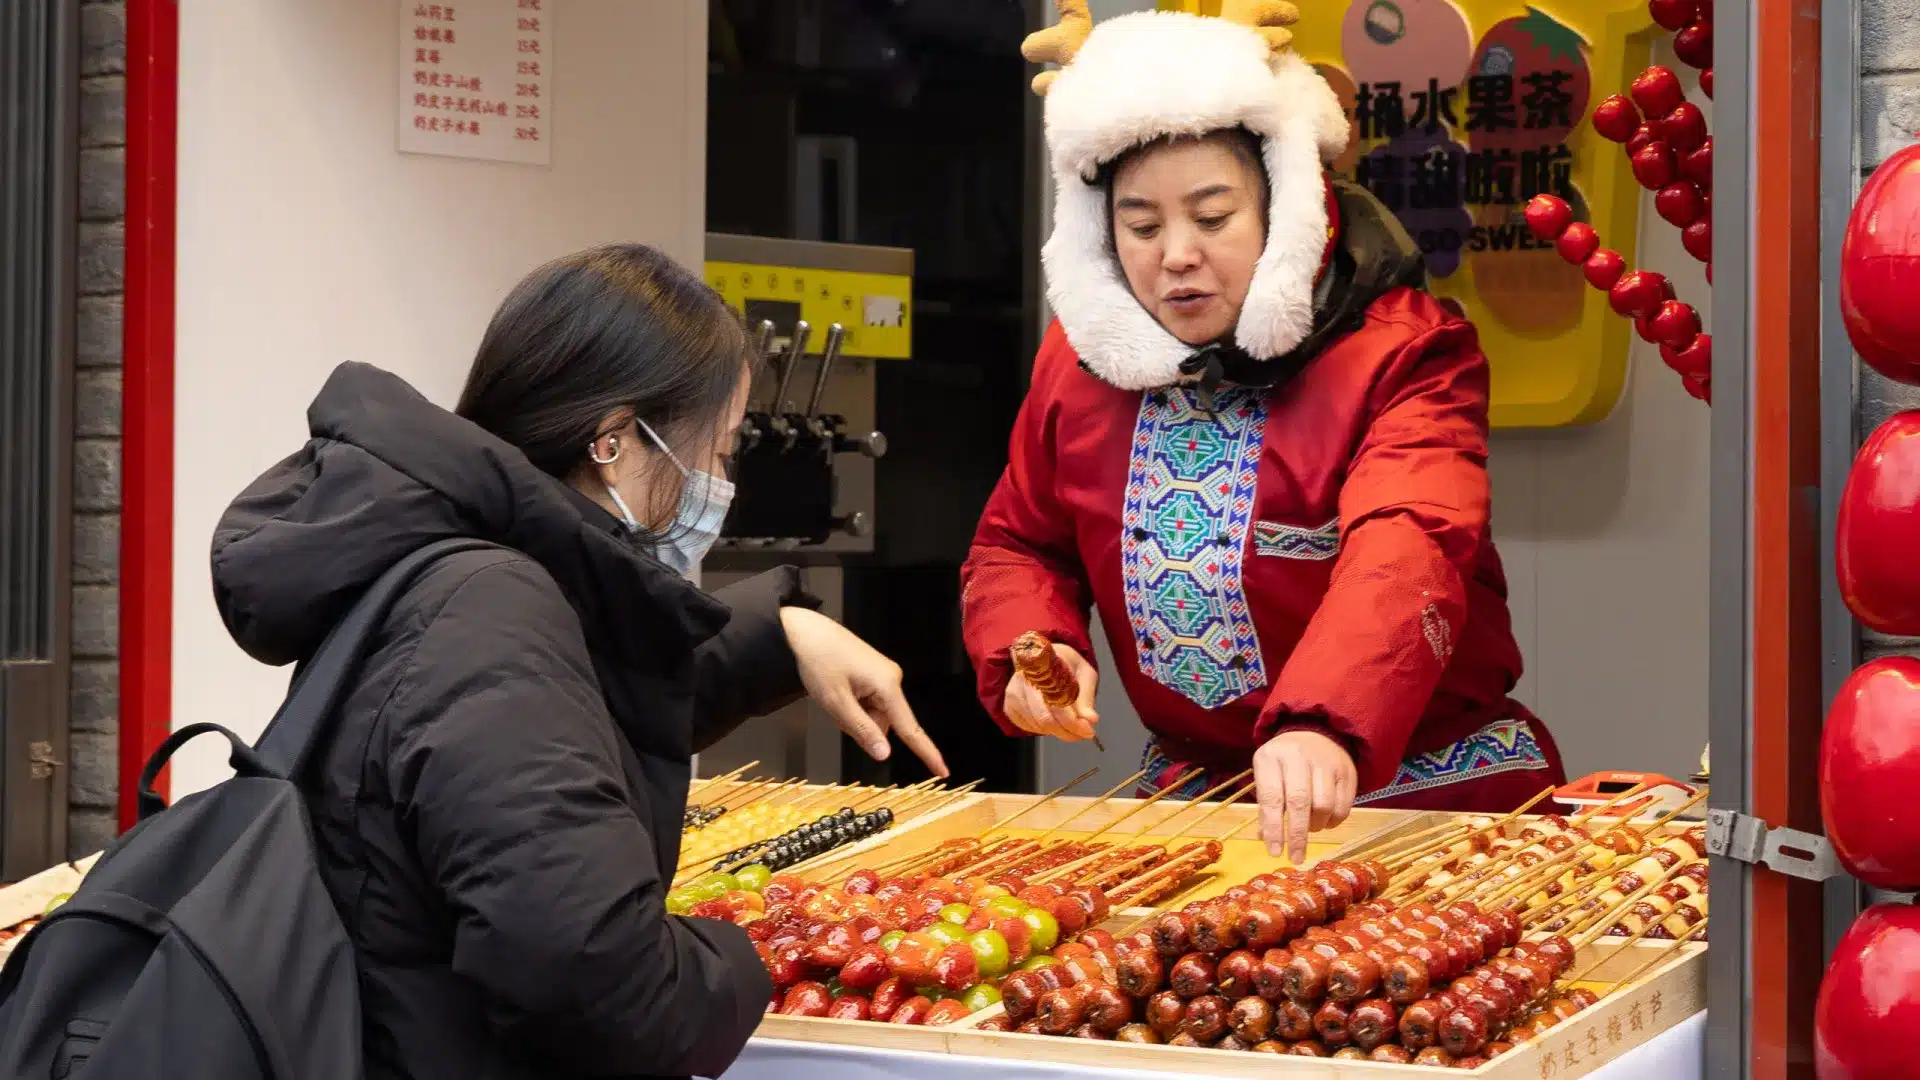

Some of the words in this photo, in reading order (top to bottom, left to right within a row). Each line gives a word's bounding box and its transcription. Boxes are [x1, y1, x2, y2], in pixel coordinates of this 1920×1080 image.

[516, 39, 541, 54] 15元
[413, 70, 482, 92] 奶皮子山楂
[1347, 70, 1573, 138] 桶水果茶
[1418, 227, 1462, 254] SO
